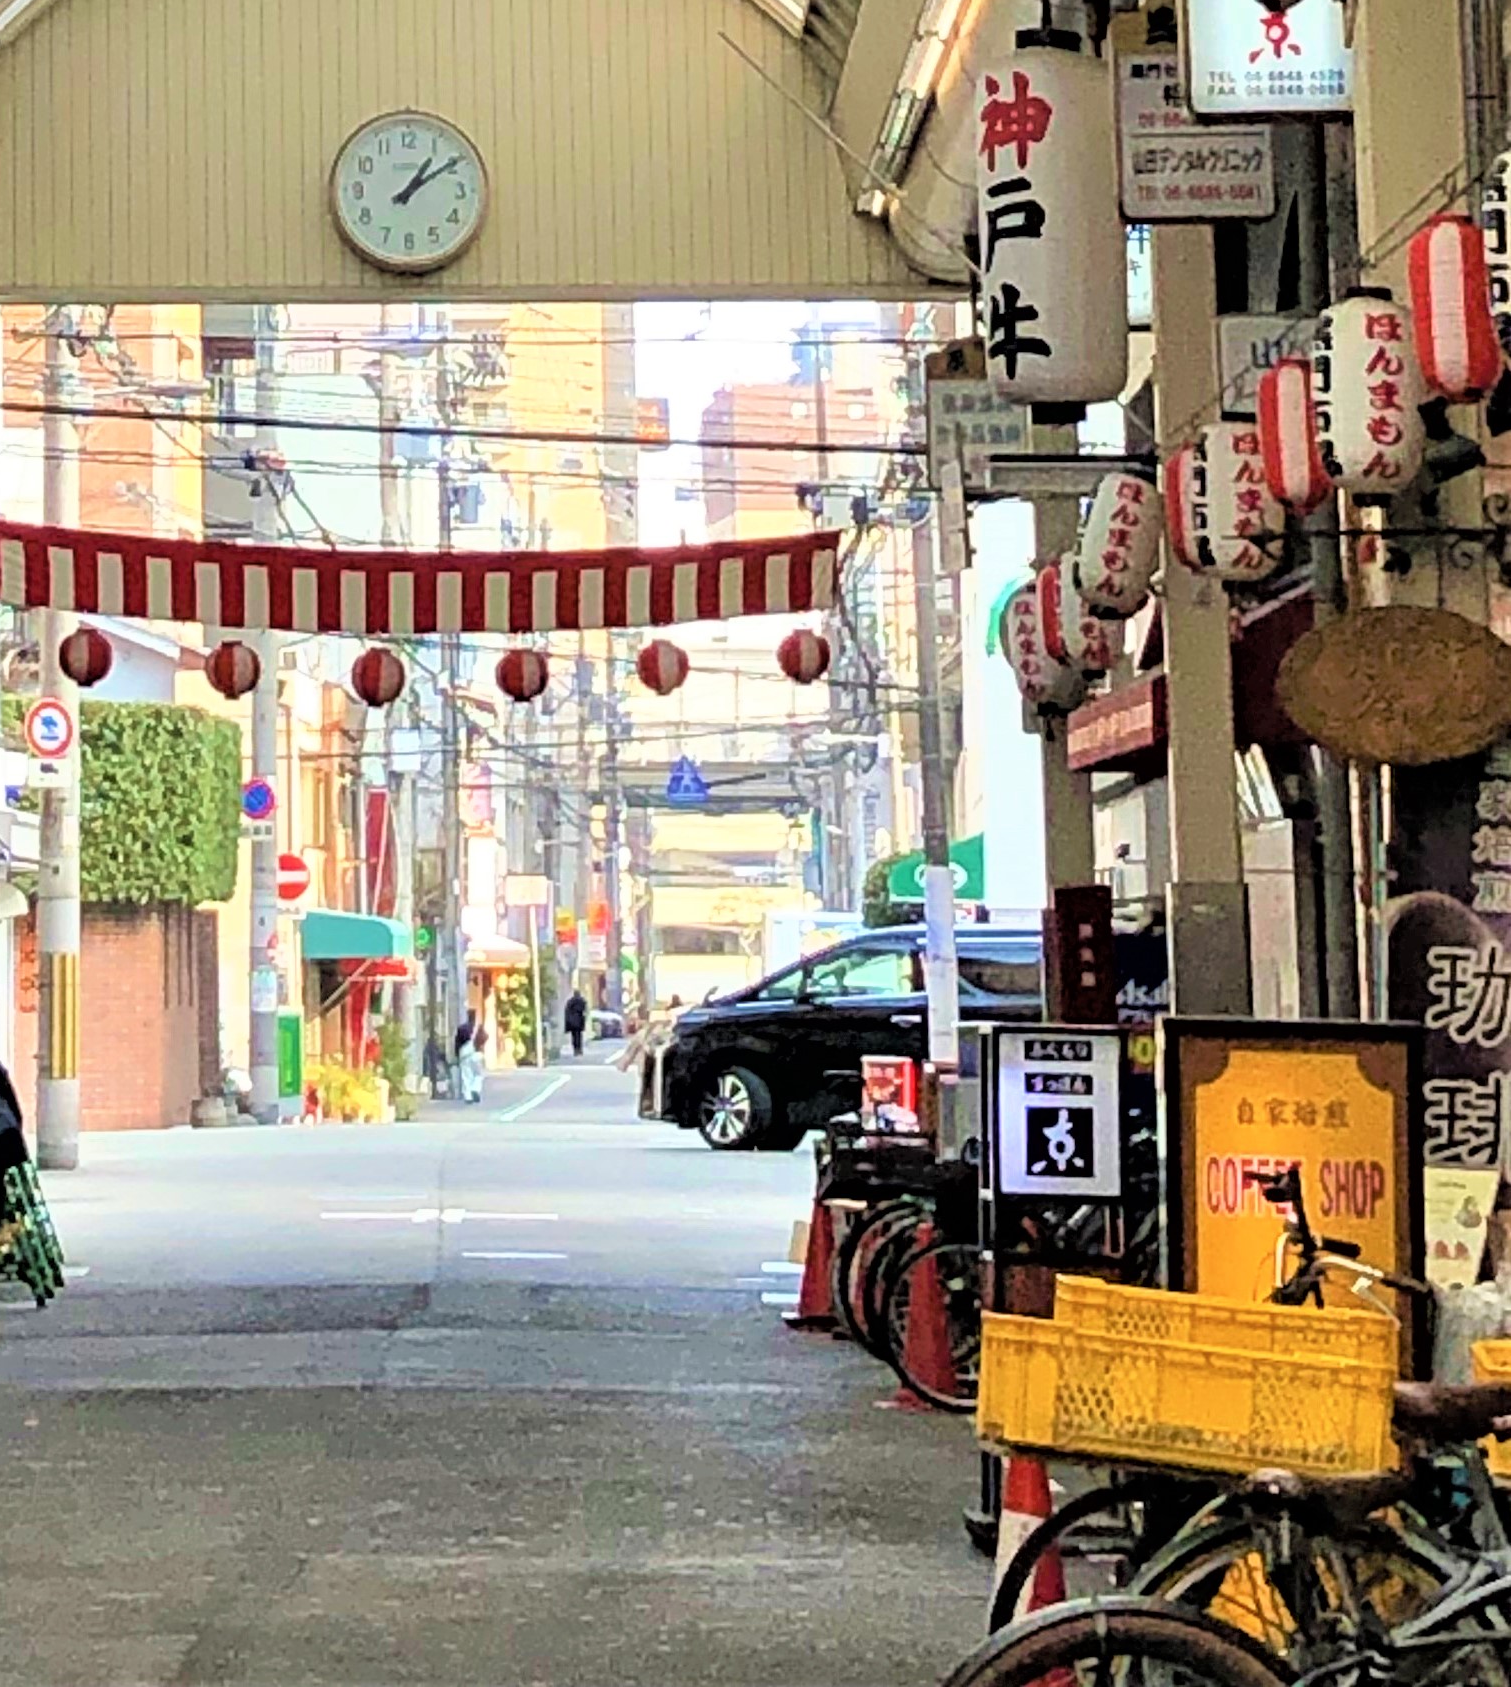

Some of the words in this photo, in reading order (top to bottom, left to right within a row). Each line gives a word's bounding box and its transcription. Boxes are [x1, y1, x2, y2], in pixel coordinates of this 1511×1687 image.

[979, 71, 1053, 380] 神戸牛
[1362, 313, 1404, 479] ほんまもん
[1320, 1158, 1384, 1219] SHOP
